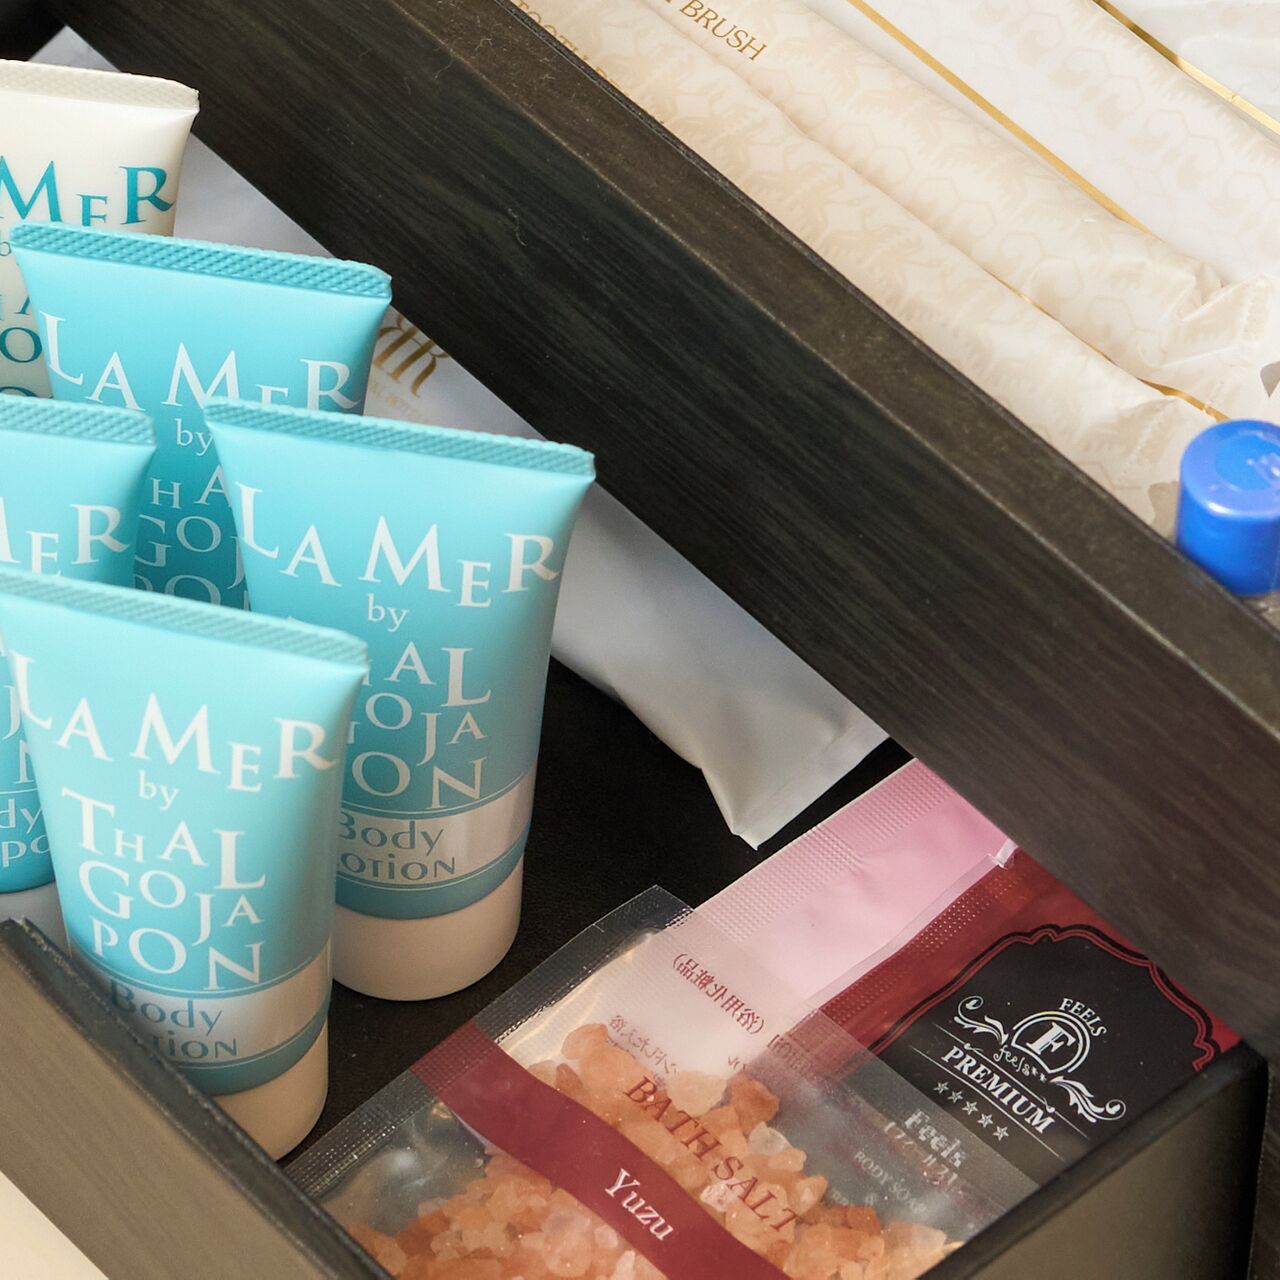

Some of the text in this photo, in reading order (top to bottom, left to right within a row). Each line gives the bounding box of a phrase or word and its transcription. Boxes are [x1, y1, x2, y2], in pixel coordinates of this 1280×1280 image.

[38, 309, 148, 413] LA
[174, 418, 214, 456] by
[235, 480, 561, 609] LA MER
[366, 593, 410, 633] by
[8, 648, 340, 794] LA MER
[354, 691, 488, 767] OJA
[137, 769, 181, 811] by
[350, 751, 488, 811] ON
[89, 917, 264, 992] PON
[110, 979, 224, 1037] Body
[1026, 1022, 1077, 1056] F
[1059, 997, 1109, 1038] FEELS
[940, 1045, 1056, 1135] PREMIUM
[623, 1075, 800, 1233] BATH SALT
[904, 1108, 968, 1169] Feels
[604, 1167, 675, 1242] Yuzu
